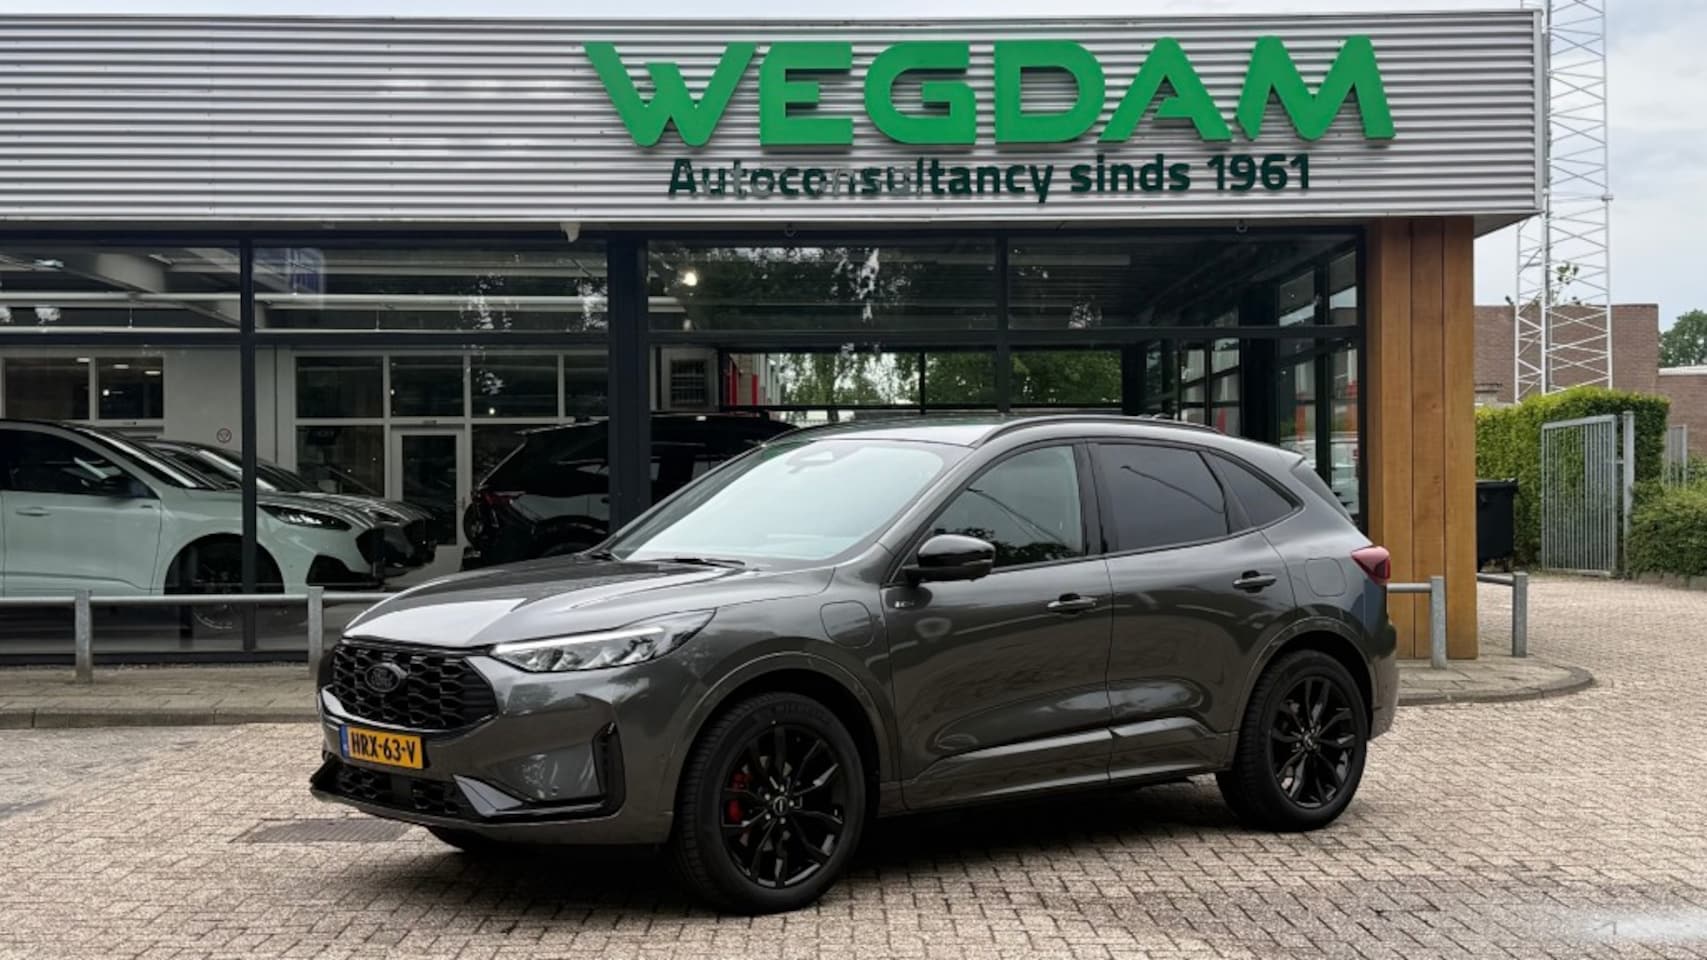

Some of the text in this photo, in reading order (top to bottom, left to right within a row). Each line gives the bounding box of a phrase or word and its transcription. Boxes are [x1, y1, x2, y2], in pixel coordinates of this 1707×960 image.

[583, 35, 1396, 147] WEGDAM
[668, 153, 1310, 203] Autoconsultancy sinds 1961
[351, 731, 416, 764] HRX-63-V
